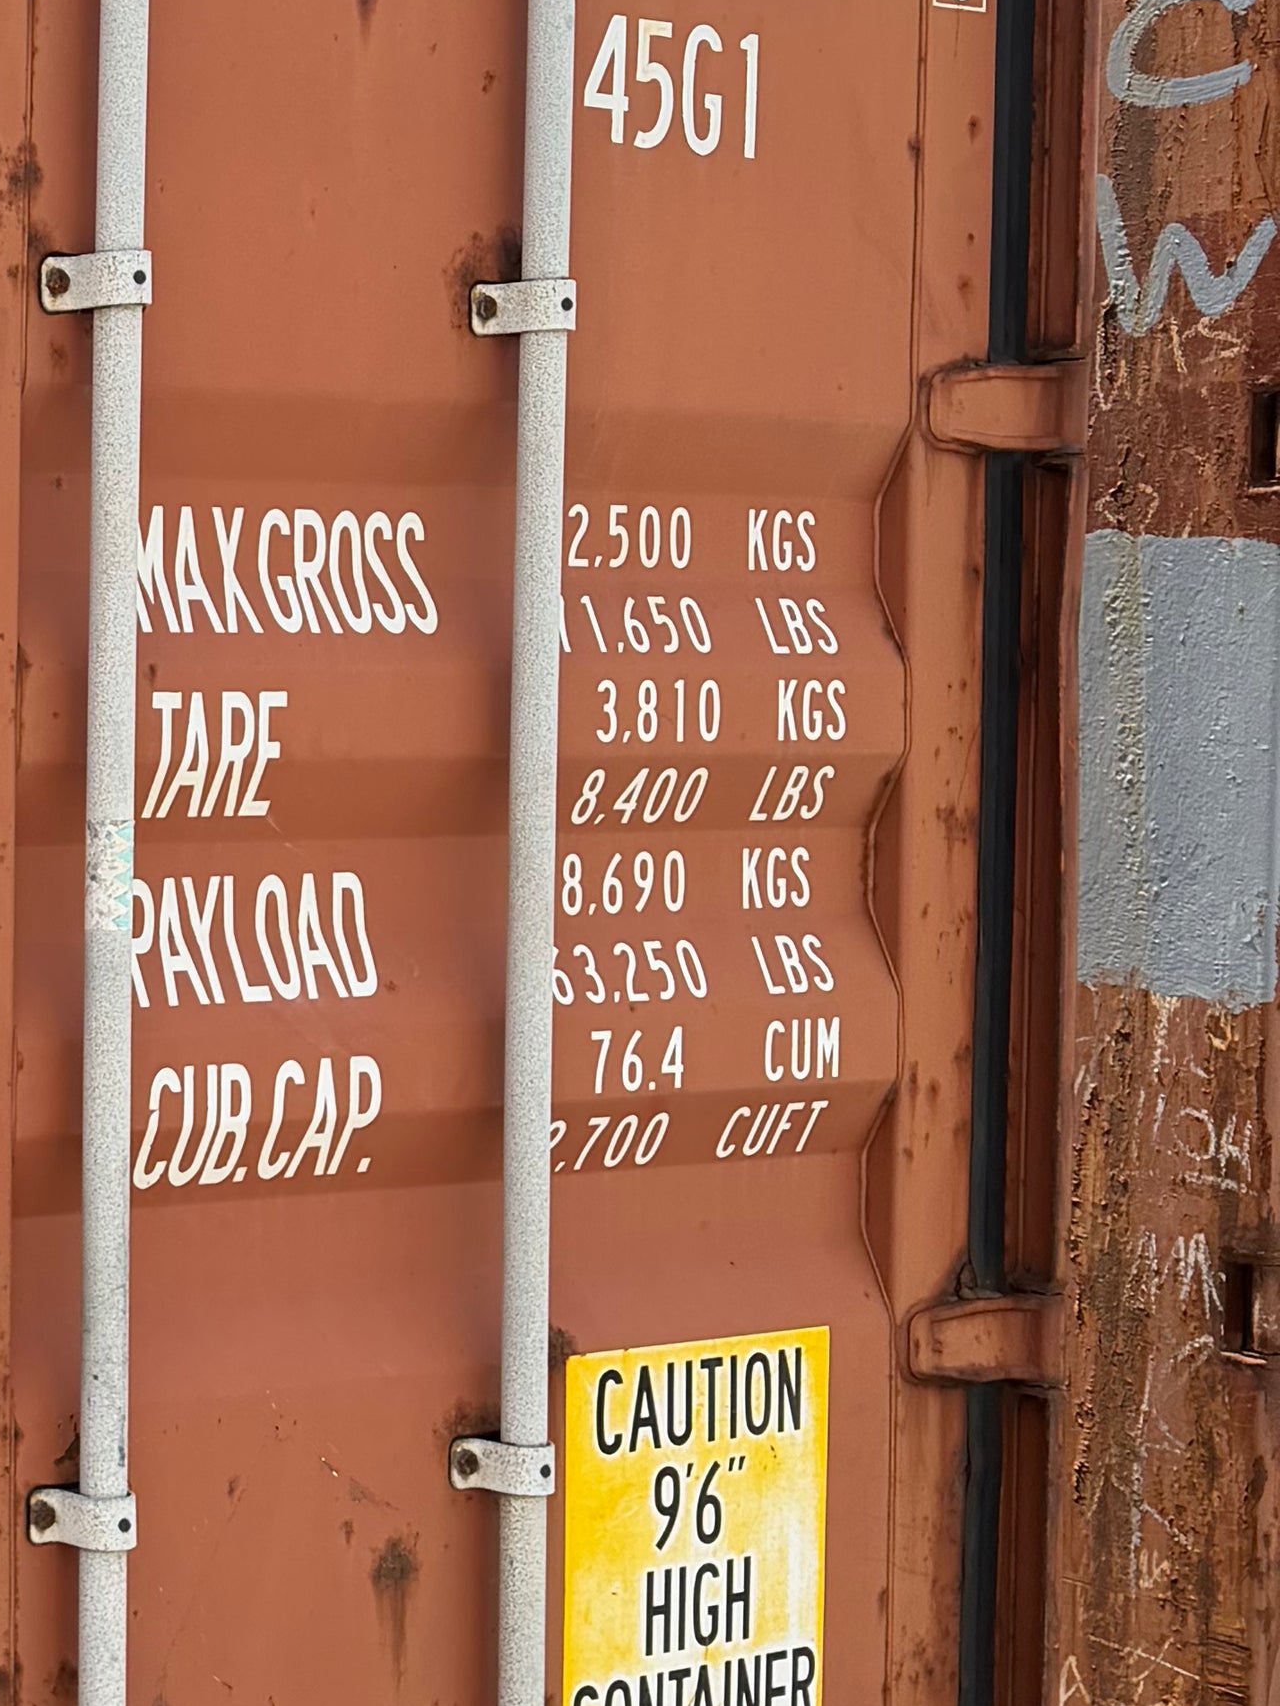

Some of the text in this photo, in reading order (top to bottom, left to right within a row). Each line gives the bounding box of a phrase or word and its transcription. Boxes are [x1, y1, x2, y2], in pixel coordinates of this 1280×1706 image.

[583, 13, 760, 160] 45G1
[136, 505, 439, 635] MAX GROSS
[747, 508, 818, 572] KGS
[755, 596, 839, 656] LBS
[595, 678, 847, 744] 3,810 KGS
[140, 690, 289, 819] TARE
[570, 765, 835, 826] 8,400 LBS
[741, 846, 812, 910] KGS
[131, 871, 380, 1008] PAYLOAD
[751, 934, 835, 995] LBS
[590, 1016, 840, 1095] 76.4 CUM
[715, 1099, 829, 1159] CUFT
[595, 1346, 803, 1456] CAUTION
[645, 1556, 752, 1657] HIGH
